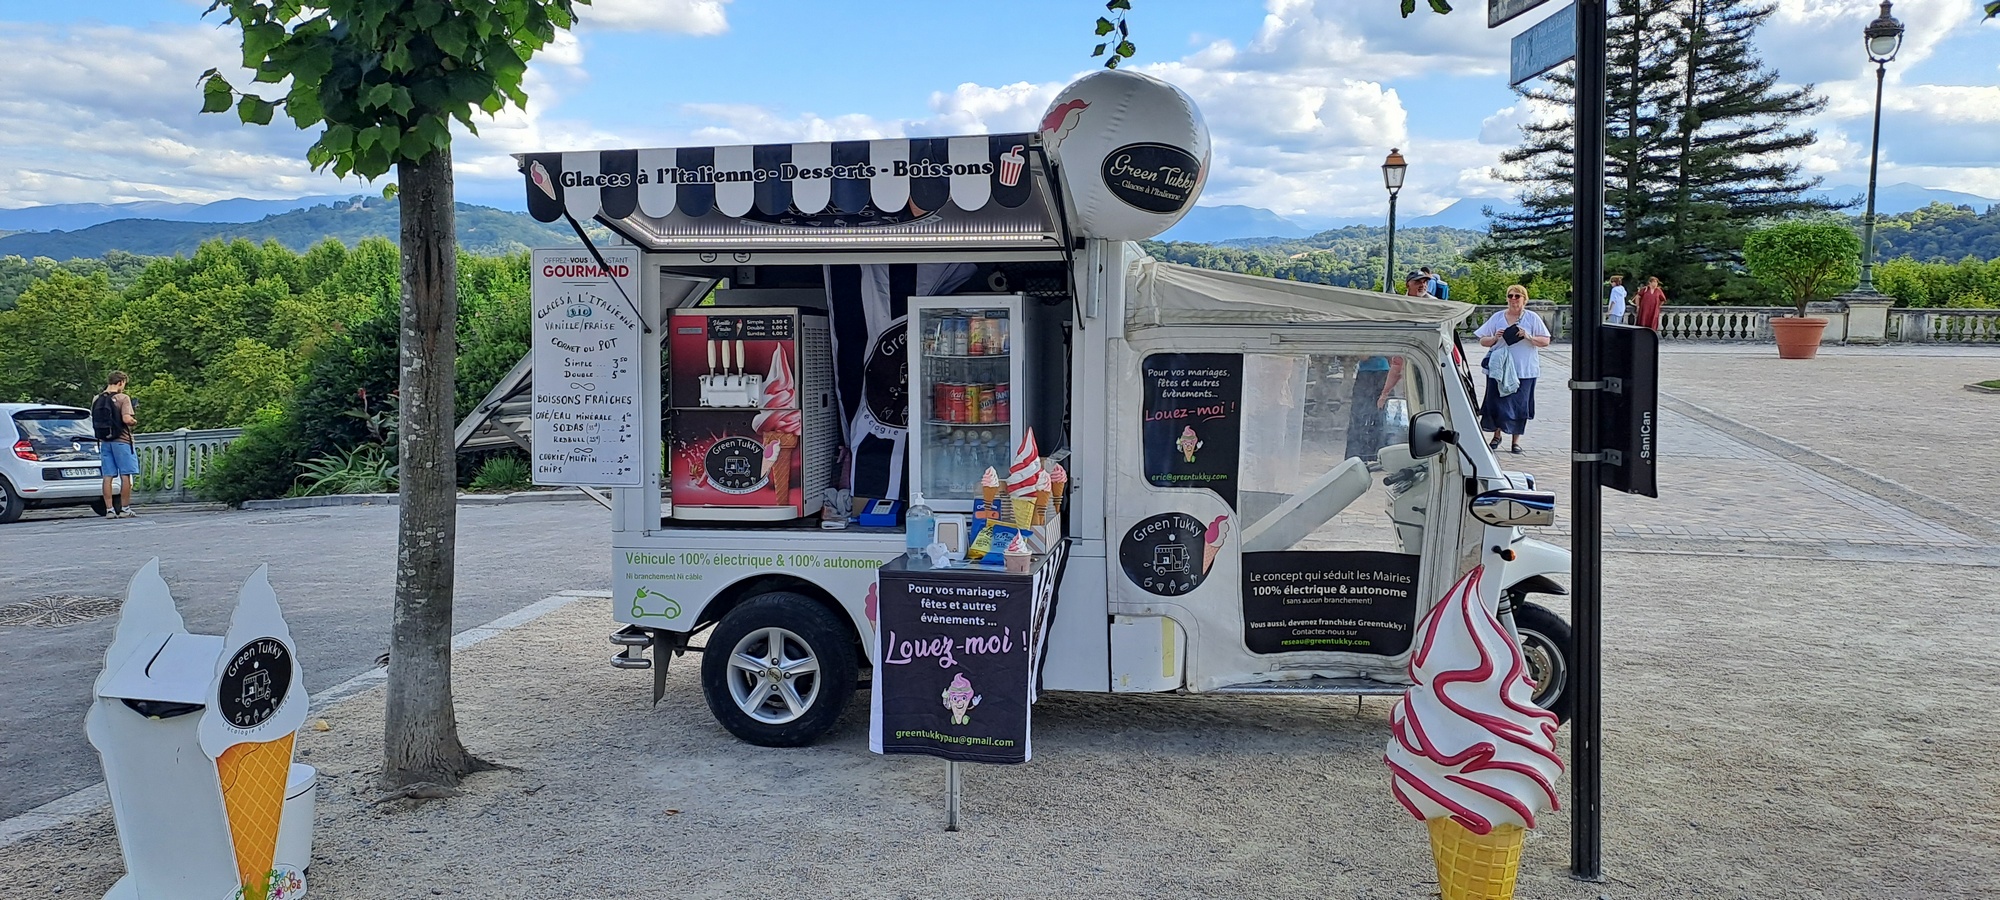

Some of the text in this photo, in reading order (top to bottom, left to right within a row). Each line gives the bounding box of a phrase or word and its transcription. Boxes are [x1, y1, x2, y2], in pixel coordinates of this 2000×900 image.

[560, 170, 631, 187] Glaces
[638, 168, 649, 184] à
[892, 158, 994, 177] Boissons
[1110, 154, 1195, 194] Green Tukky
[1121, 180, 1144, 192] Glaces
[543, 256, 588, 264] OFFREZ-VOUS
[543, 265, 629, 277] GOURMAND
[537, 296, 565, 319] GLACES
[551, 337, 580, 353] CORNET
[598, 338, 617, 351] POT
[1148, 368, 1168, 377] Pour
[1188, 367, 1230, 378] mariages,
[1158, 378, 1179, 387] fêtes
[1192, 379, 1220, 387] autres
[537, 393, 580, 404] BOISSONS
[1145, 401, 1226, 421] Louez-moi
[553, 423, 583, 432] SODAS
[1640, 411, 1651, 459] SaniCan
[712, 438, 761, 455] Green Tukky
[539, 463, 562, 474] CHIPS
[1151, 472, 1227, 482] eric@greentukky.com
[1133, 516, 1202, 541] Green Tukky
[626, 552, 883, 569] Véhicule 100% électrique & 100% autonome
[634, 572, 676, 580] branchement
[686, 572, 703, 580] câble
[1250, 570, 1411, 583] Le concept qui séduit les Mairies
[908, 583, 1010, 599] Pour vos mariages,
[1253, 584, 1408, 598] 100% électrique & autonome
[920, 598, 997, 611] fêtes et autres
[1323, 596, 1372, 605] branchement)
[920, 613, 986, 626] évènements
[1267, 619, 1287, 627] aussi,
[1318, 618, 1356, 626] franchisés
[1358, 619, 1402, 631] Greentukky
[884, 626, 1028, 669] Louez-moi !
[1281, 637, 1370, 646] reseau@greentukky.com
[228, 641, 283, 677] Green Tukky
[895, 730, 1014, 747] greentukkypau@gmail.com
